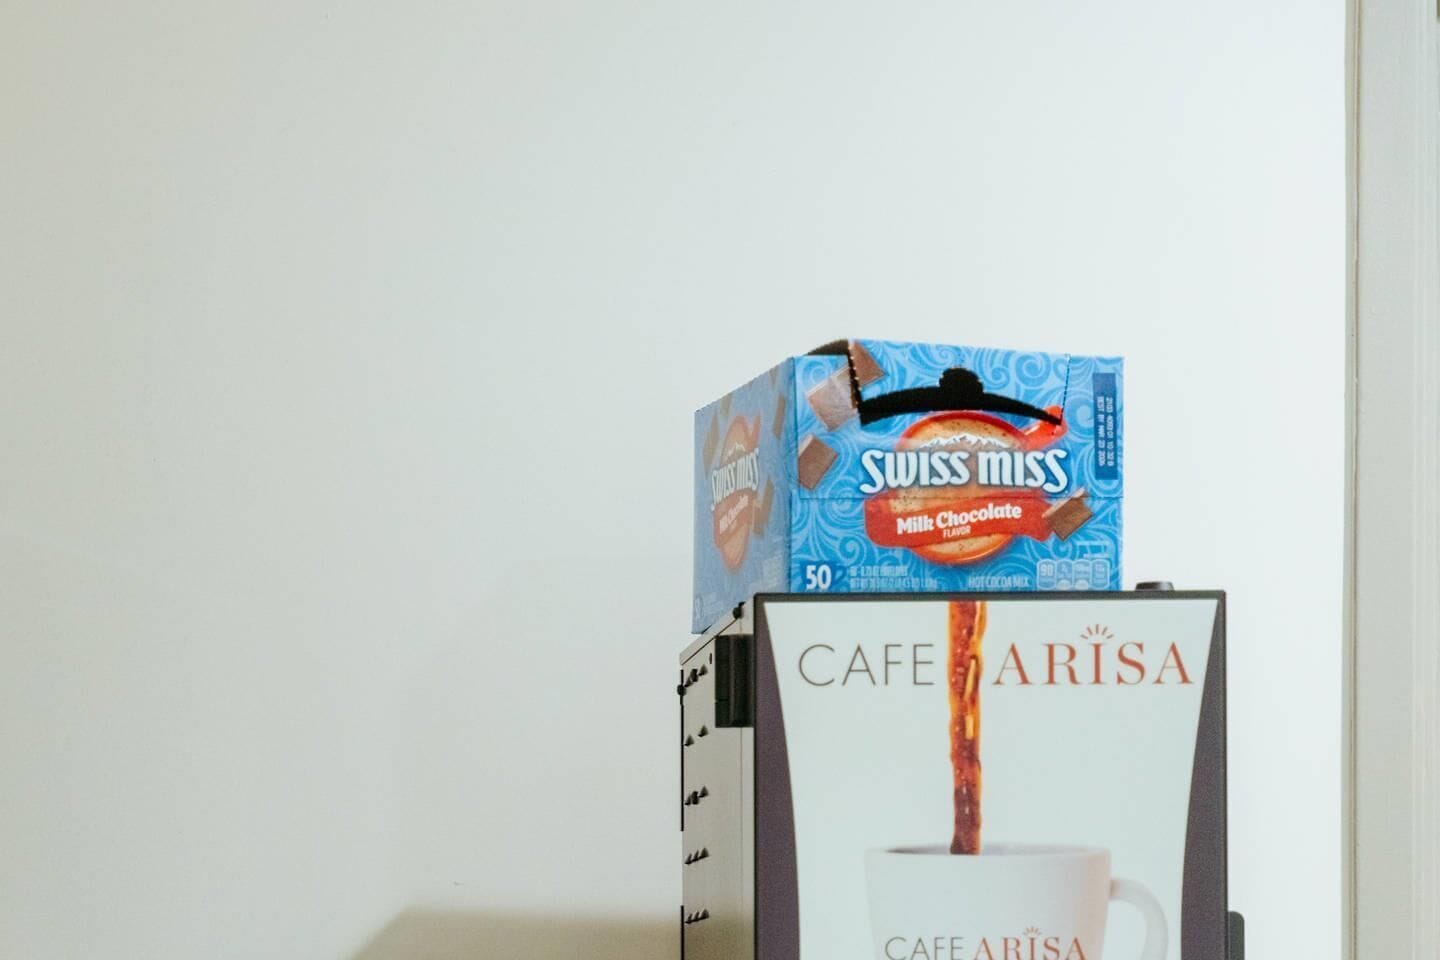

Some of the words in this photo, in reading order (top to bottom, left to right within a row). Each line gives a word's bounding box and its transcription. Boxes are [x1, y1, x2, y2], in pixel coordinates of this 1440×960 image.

[860, 450, 970, 494] SWISS
[978, 449, 1068, 493] MISS
[896, 515, 935, 535] Milk
[935, 502, 1022, 529] Chocolate
[943, 525, 971, 538] FLAVOR
[806, 564, 832, 590] 50
[798, 643, 935, 687] CAFE
[992, 640, 1194, 686] ARISA
